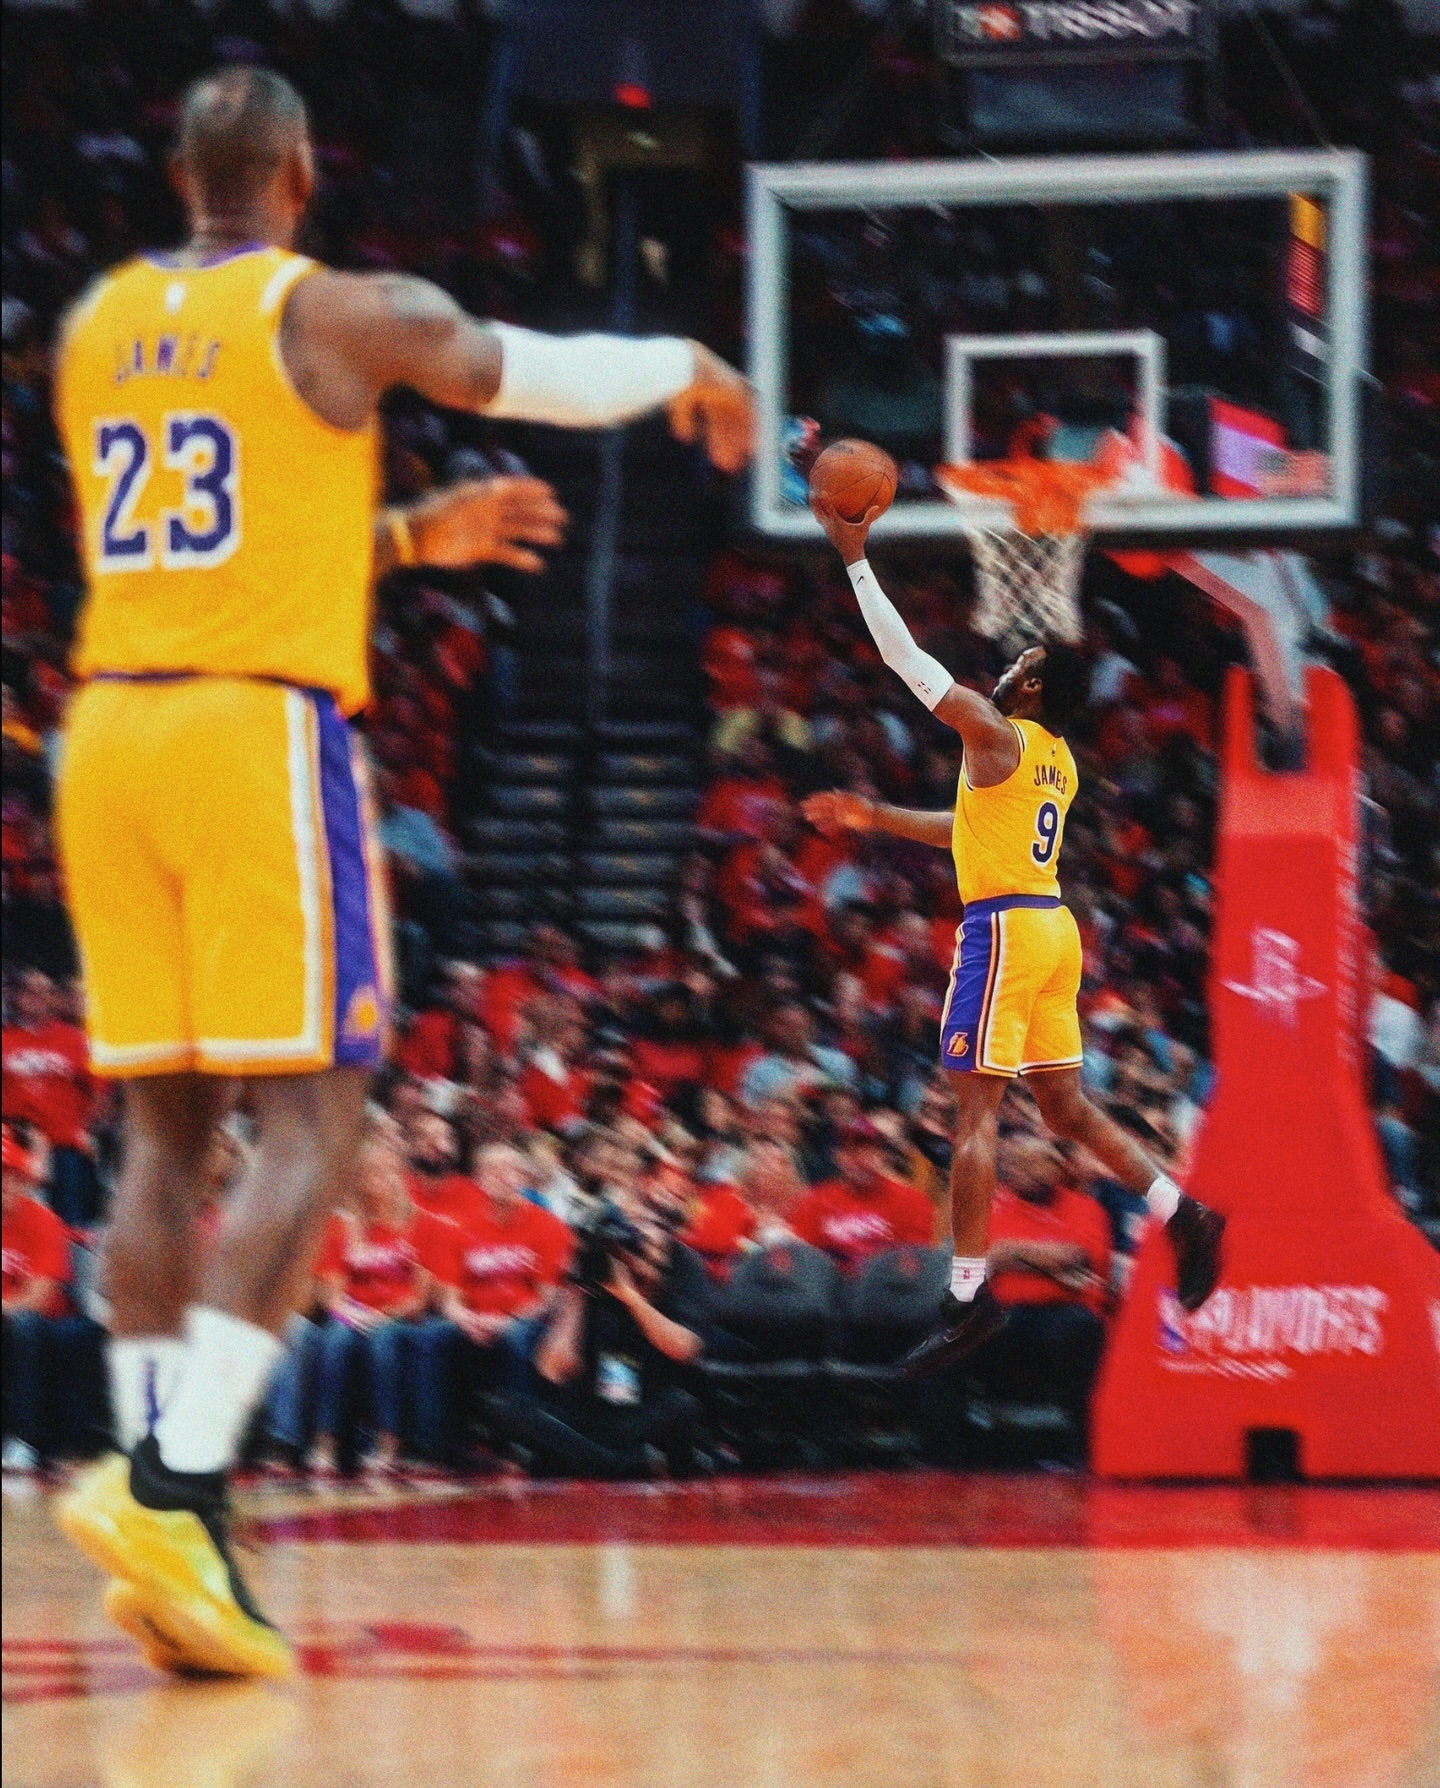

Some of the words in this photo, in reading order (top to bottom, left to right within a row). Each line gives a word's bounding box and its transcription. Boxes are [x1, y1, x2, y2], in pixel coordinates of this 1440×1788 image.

[95, 413, 242, 571] 23
[1034, 765, 1067, 795] JAMES
[1032, 801, 1058, 866] 9
